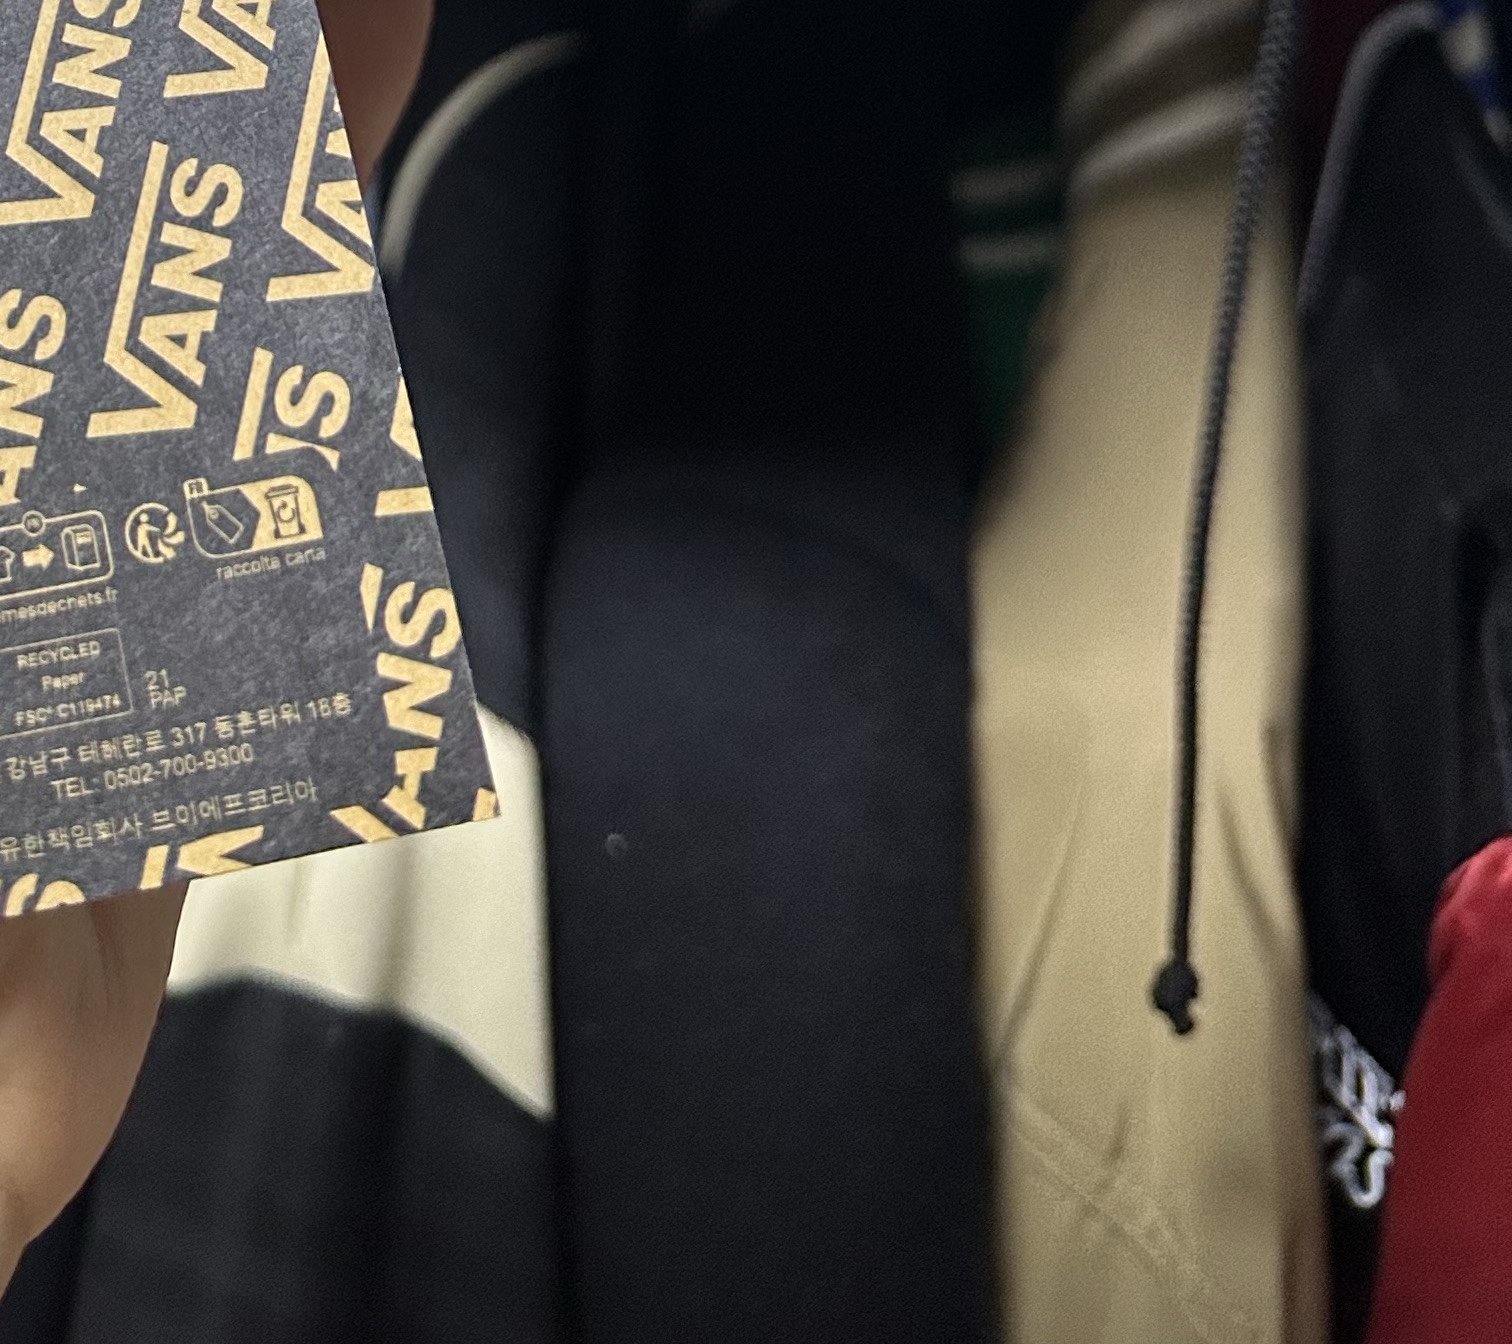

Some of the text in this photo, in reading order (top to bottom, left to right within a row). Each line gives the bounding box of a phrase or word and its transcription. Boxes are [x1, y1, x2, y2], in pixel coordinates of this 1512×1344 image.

[87, 141, 244, 438] VANS
[16, 640, 102, 670] RECYCLED
[41, 670, 88, 693] Paper
[144, 668, 170, 690] 21
[149, 685, 187, 711] PAP
[5, 745, 72, 782] 강남구
[77, 728, 167, 764] 테헤란로
[168, 721, 208, 748] 317
[305, 692, 353, 722] 18층
[150, 775, 319, 832] 브이에프코리아
